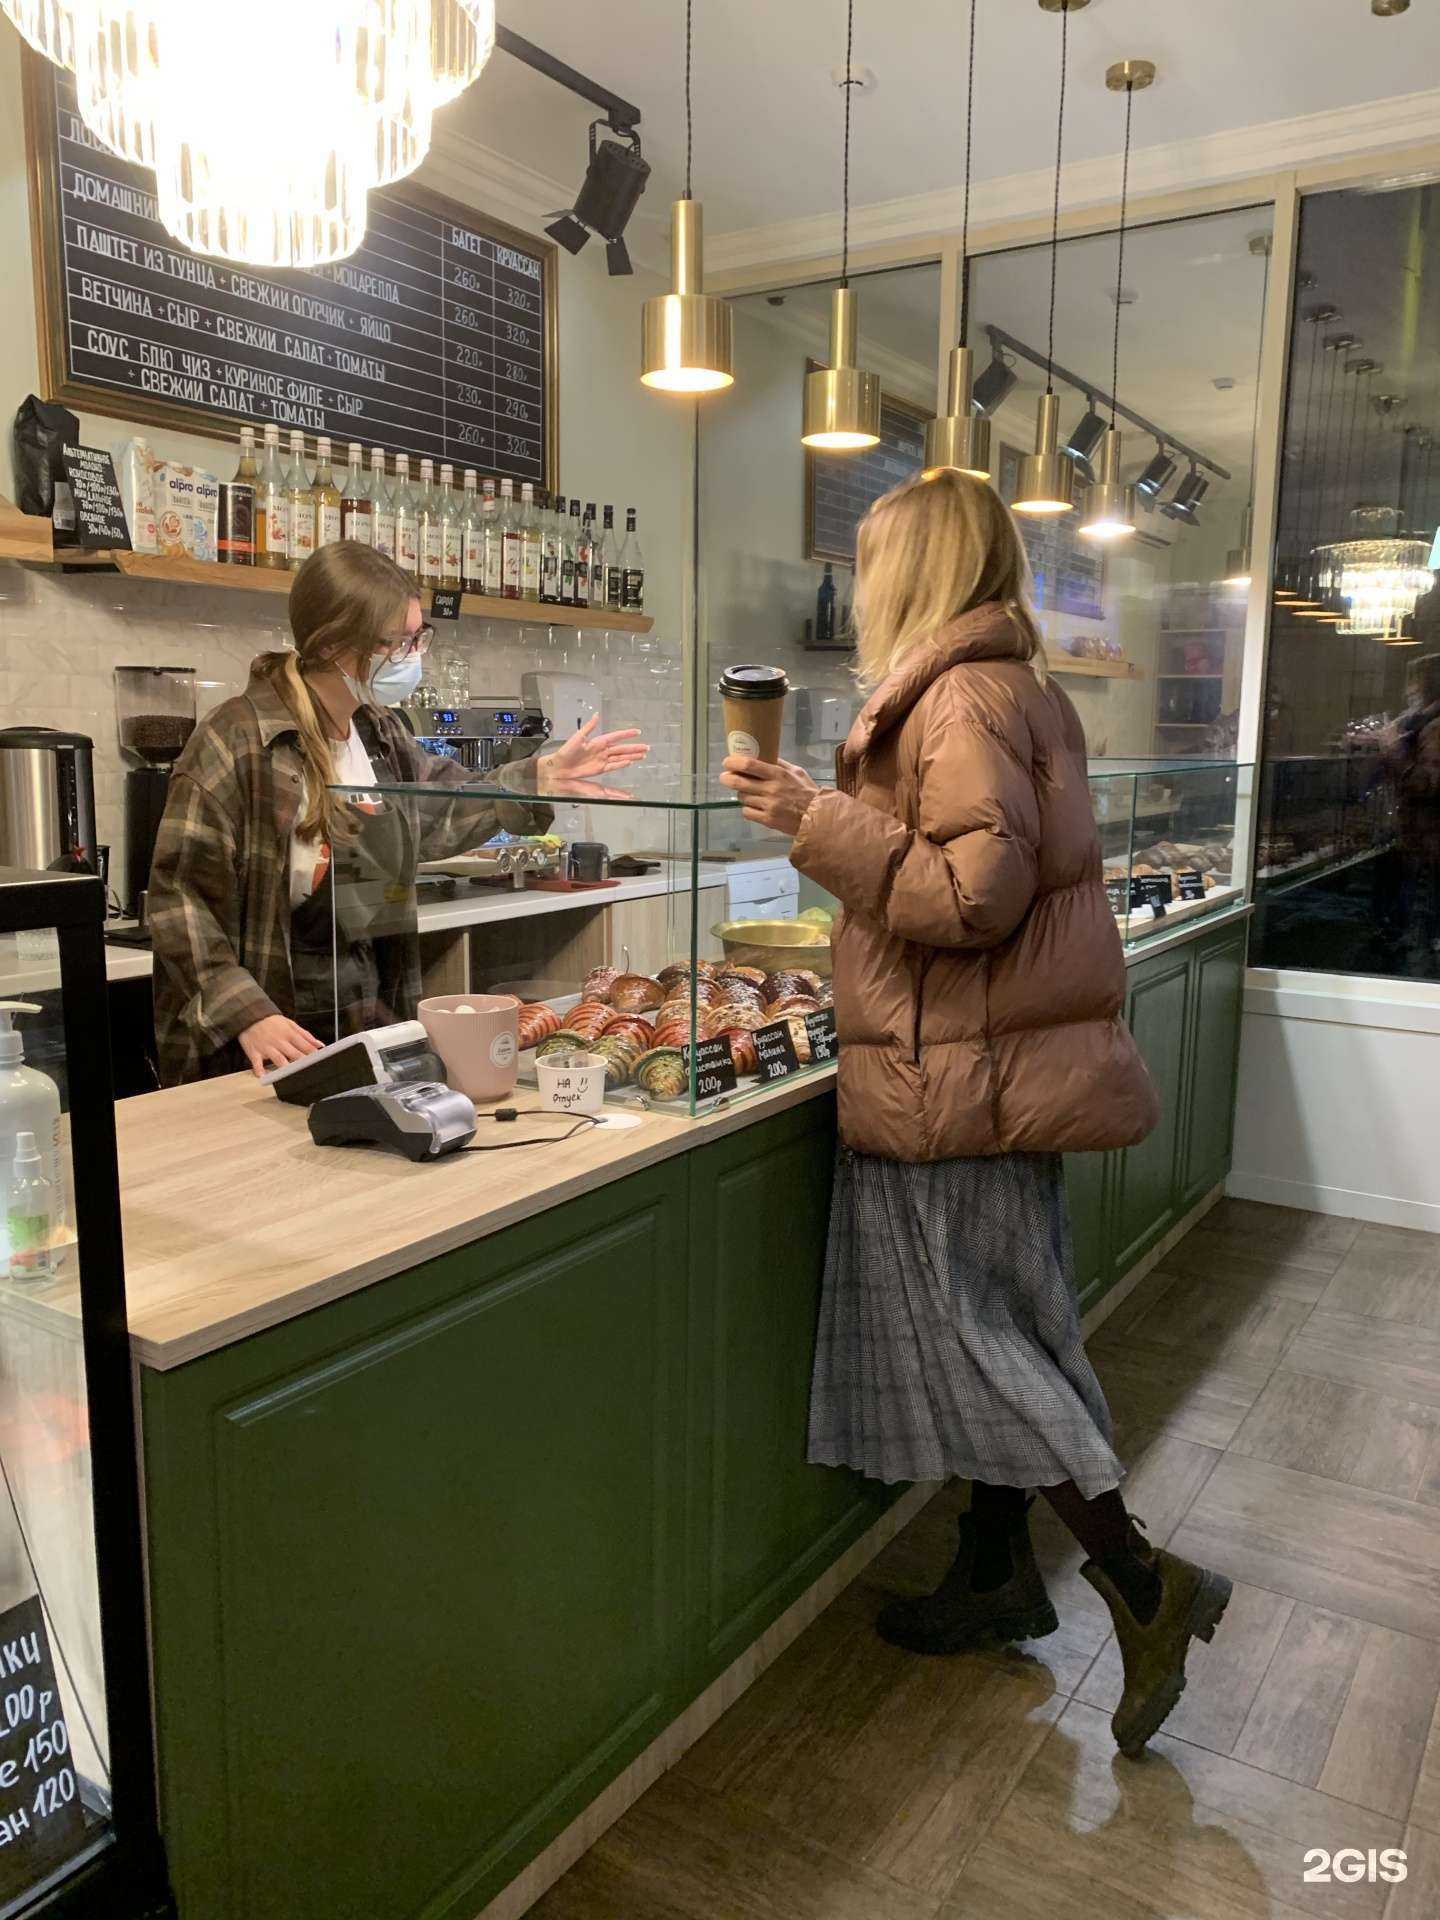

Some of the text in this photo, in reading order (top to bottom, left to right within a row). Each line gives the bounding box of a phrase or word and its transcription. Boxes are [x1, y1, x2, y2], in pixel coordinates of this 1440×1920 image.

[451, 227, 481, 256] БАГЕТ
[496, 245, 541, 280] КРУАССАН
[77, 225, 138, 264] ПАШТЕТ
[143, 246, 164, 273] ИЗ
[168, 254, 216, 289] ТУНЦА
[292, 296, 347, 329] ОГУРЧИК
[81, 277, 152, 316] ВЕТЧИНА
[167, 302, 200, 329] СЫР
[284, 335, 325, 363] САЛАТ
[334, 350, 385, 381] ТОМАТЫ
[87, 329, 130, 359] СОУС
[139, 342, 174, 371] БЛЮ
[182, 353, 211, 380] ЧИЗ
[224, 364, 284, 398] КУРИНОЕ
[287, 381, 324, 408] ФИЛЕ
[337, 394, 364, 416] СЫР
[210, 384, 255, 414] САЛАТ
[270, 399, 325, 429] ТОМАТЫ
[169, 478, 194, 493] alpro
[682, 1044, 724, 1061] Куассан
[23, 1720, 68, 1773] 150
[33, 1768, 75, 1818] 120
